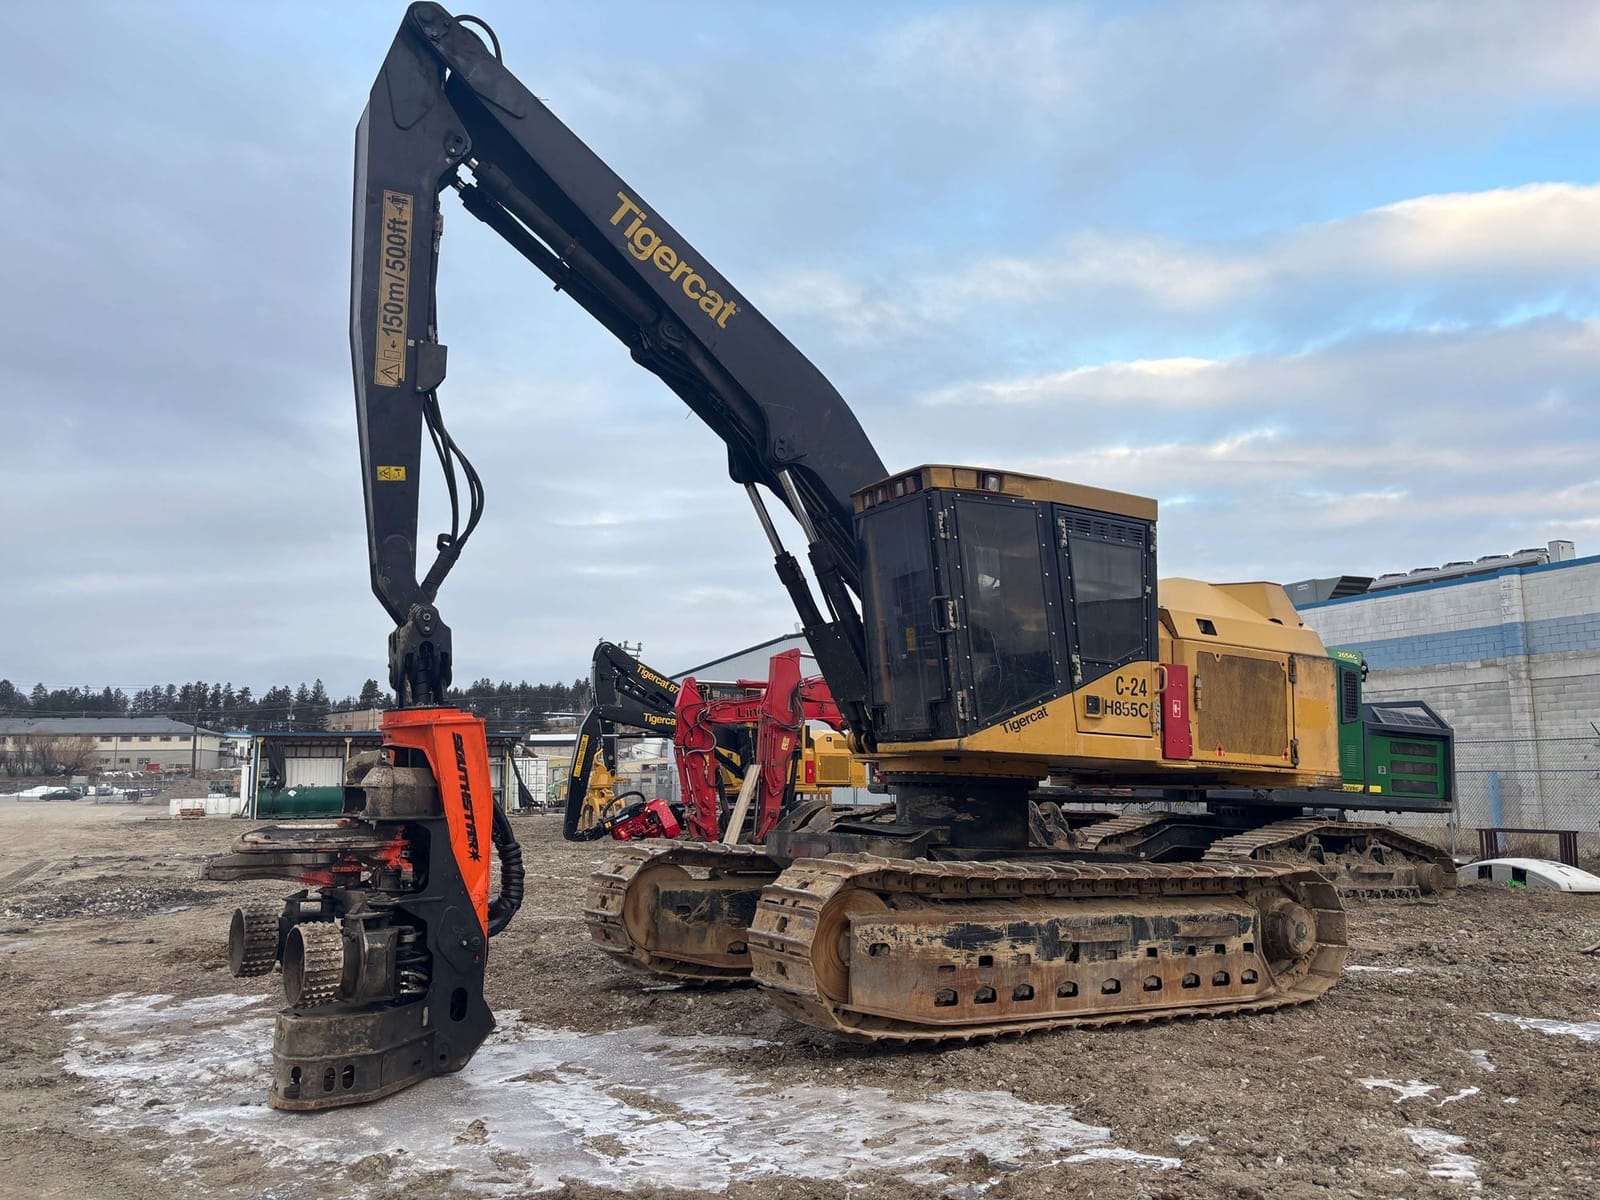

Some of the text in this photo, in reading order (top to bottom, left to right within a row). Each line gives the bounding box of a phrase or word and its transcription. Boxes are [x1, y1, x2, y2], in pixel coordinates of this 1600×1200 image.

[609, 191, 737, 329] Tigercat
[382, 219, 408, 336] 150m/500ft
[637, 664, 680, 694] Tigercat 87
[1116, 676, 1148, 697] C-24
[643, 712, 677, 725] Tigerca
[1000, 706, 1049, 735] Tigercat
[1104, 700, 1149, 719] H855C
[452, 732, 479, 851] SOUTHSTAR
